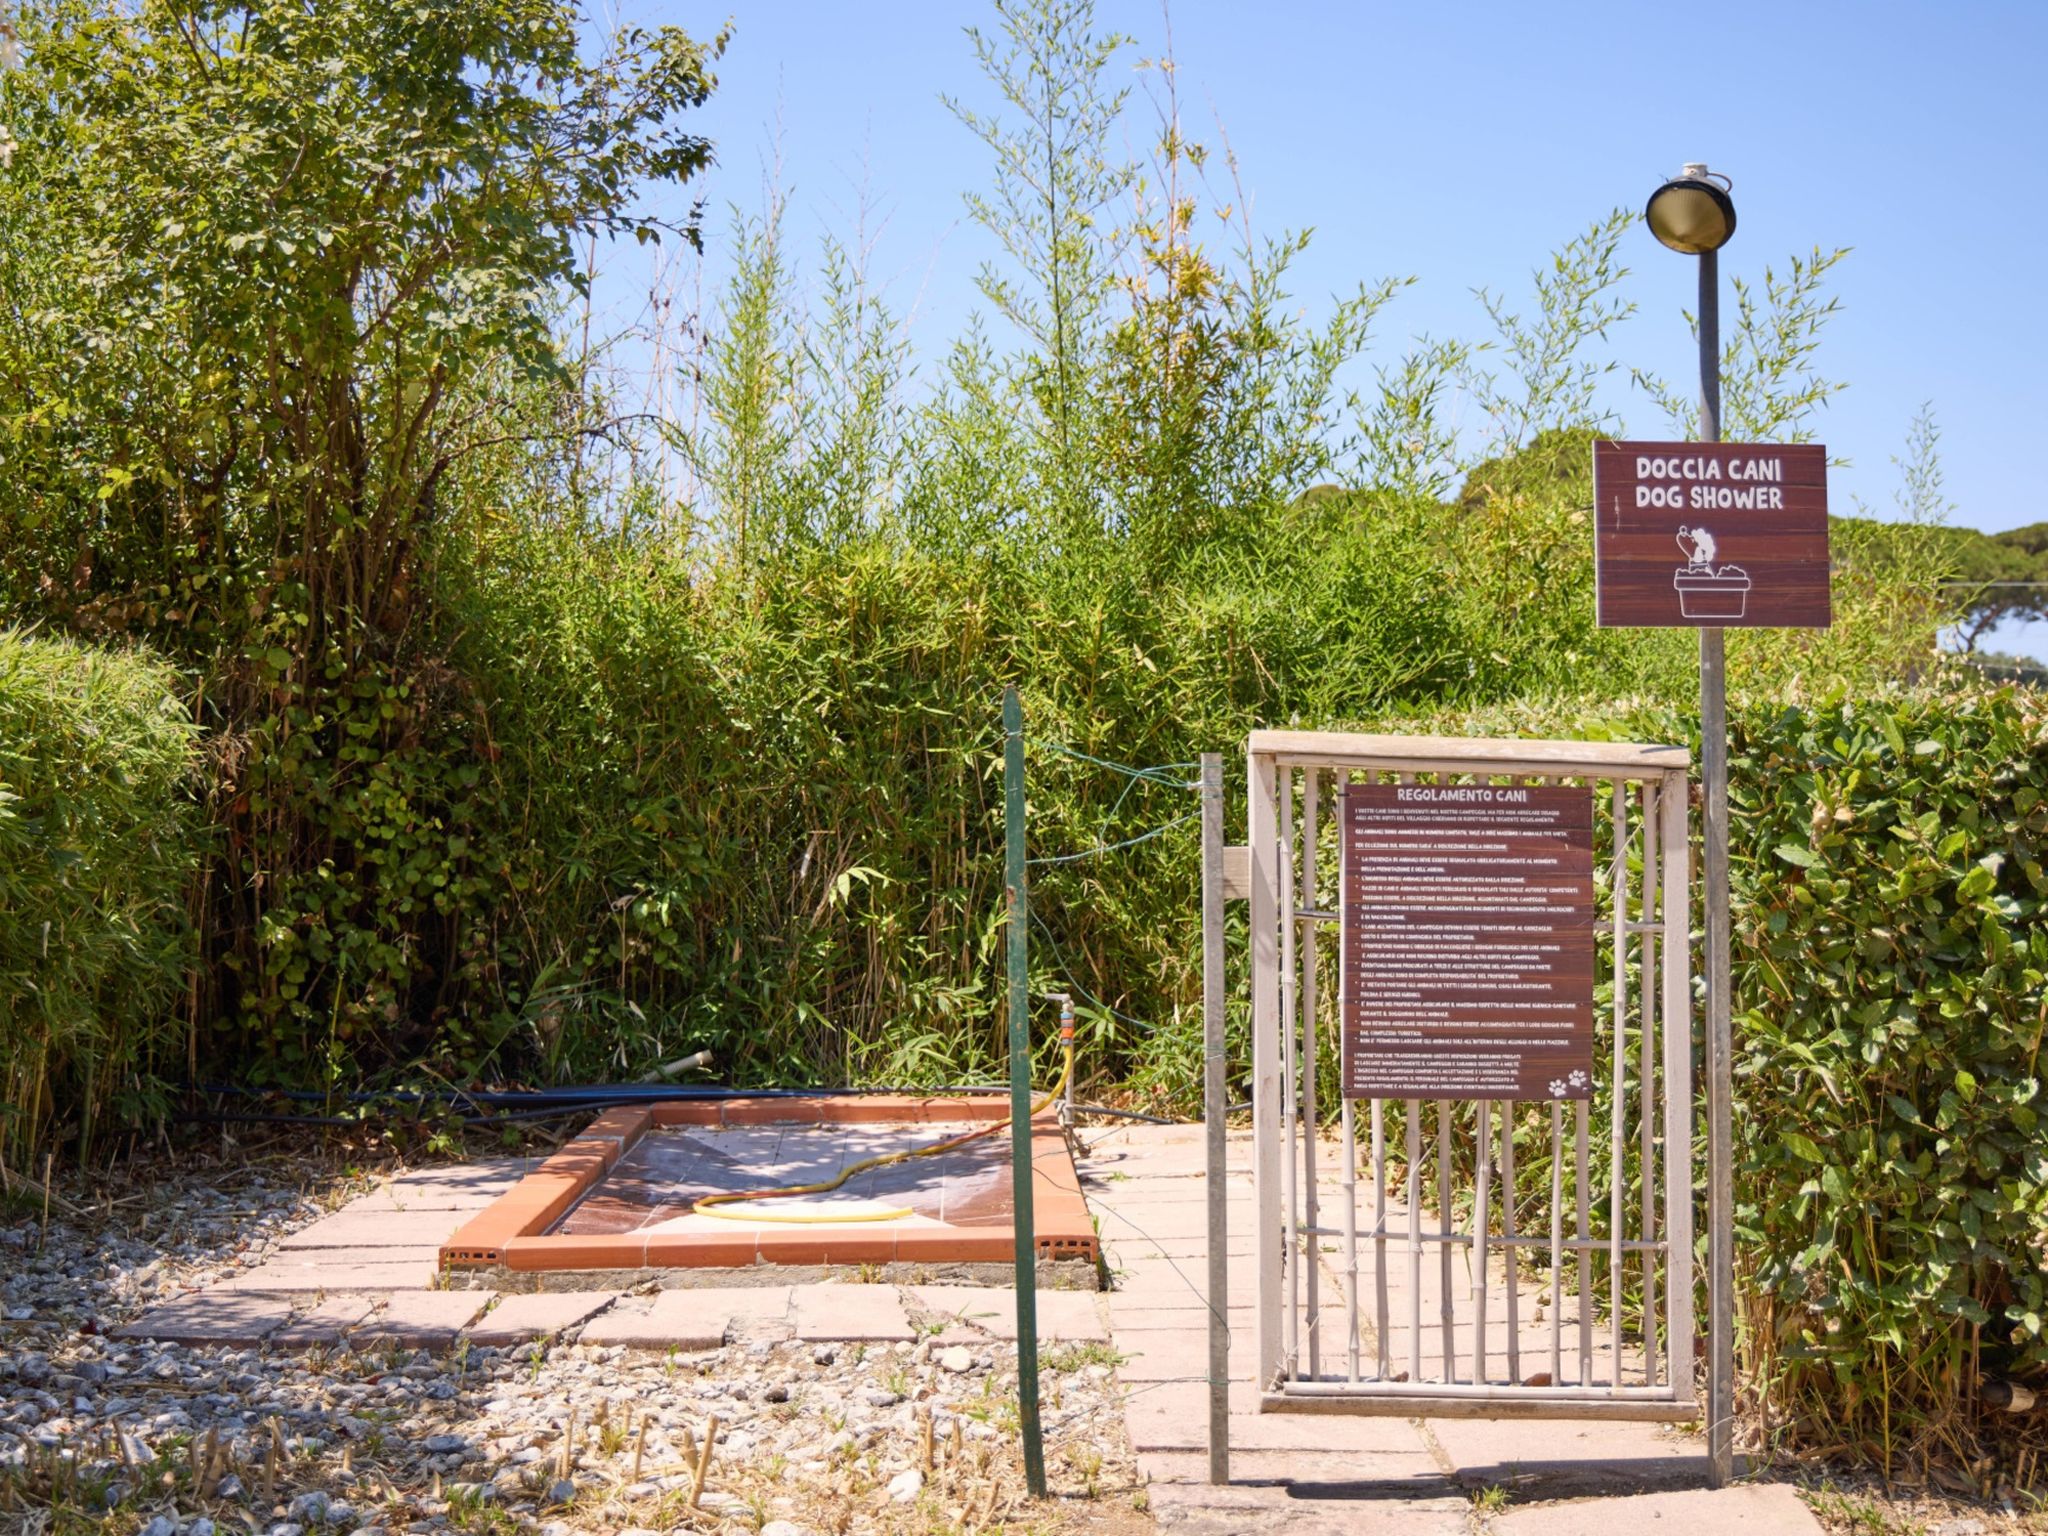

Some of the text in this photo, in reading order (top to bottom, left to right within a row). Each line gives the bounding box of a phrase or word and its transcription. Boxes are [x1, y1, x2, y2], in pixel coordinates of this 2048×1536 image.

[1636, 457, 1781, 481] DOCCIA CANI
[1636, 486, 1783, 509] DOG SHOWER
[1397, 788, 1526, 802] REGOLAMENTO CANI
